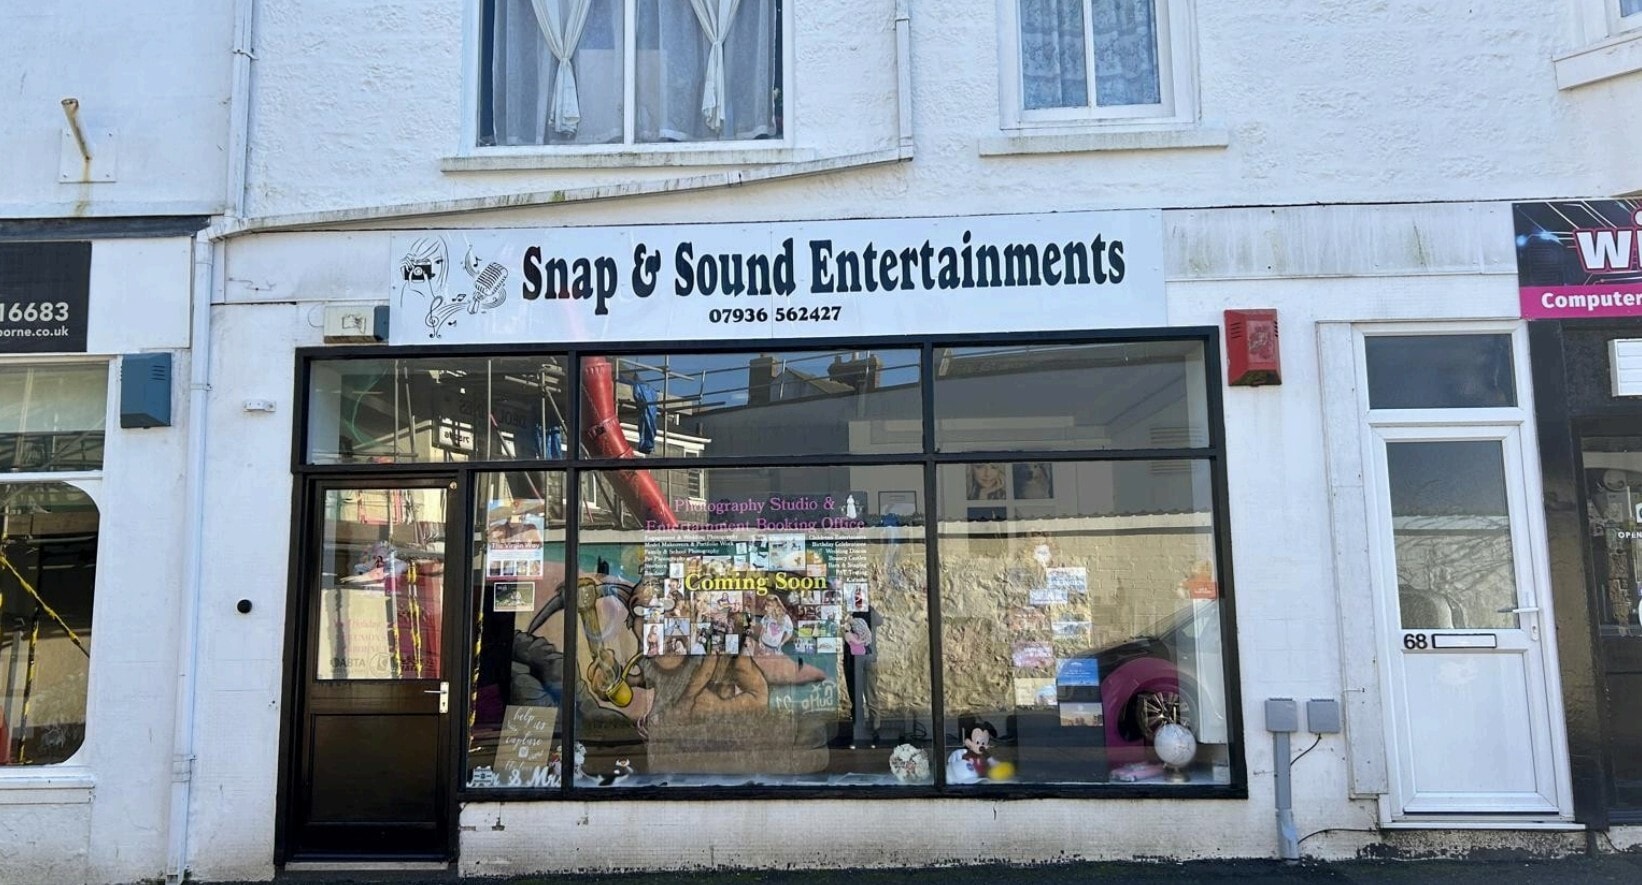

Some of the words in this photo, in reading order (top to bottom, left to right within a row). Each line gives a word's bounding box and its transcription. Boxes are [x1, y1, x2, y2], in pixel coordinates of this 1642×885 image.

[522, 246, 618, 315] Snap
[632, 243, 661, 298] &
[675, 237, 796, 297] Sound
[809, 230, 1126, 292] Entertainments
[0, 302, 69, 322] 16683
[709, 308, 768, 323] 07936
[775, 306, 841, 322] 562427
[674, 498, 765, 515] Photography
[770, 497, 818, 511] Studio
[823, 497, 835, 510] &
[646, 519, 749, 532] Entertainment
[756, 518, 816, 532] Booking
[821, 517, 865, 531] Office
[685, 573, 770, 596] Coming
[775, 571, 828, 590] Soon
[1403, 633, 1428, 649] 68
